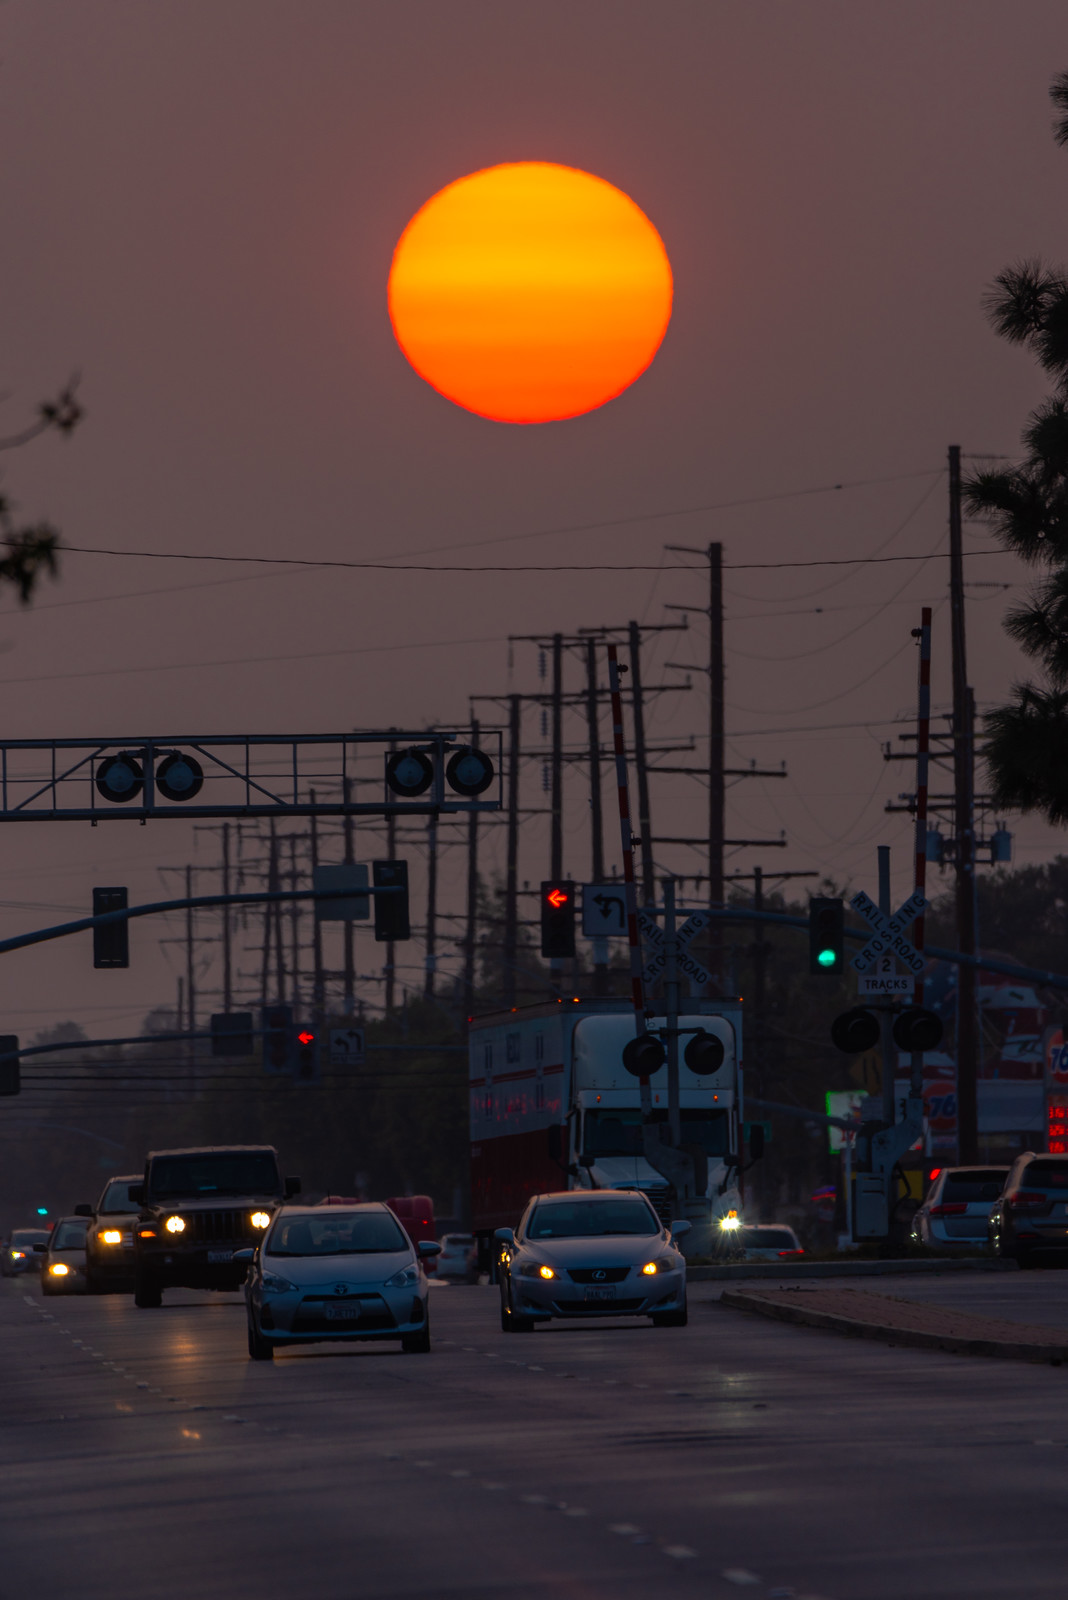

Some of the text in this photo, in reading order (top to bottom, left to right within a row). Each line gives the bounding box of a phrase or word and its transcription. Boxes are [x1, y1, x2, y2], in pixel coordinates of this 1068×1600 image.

[853, 895, 923, 970] RAIL ROAD
[854, 895, 925, 970] CROSSING
[641, 916, 702, 984] CROING
[676, 953, 707, 984] ROAD
[882, 958, 891, 972] 2
[865, 980, 908, 990] TRACKS
[1051, 1043, 1068, 1070] 76
[930, 1094, 956, 1117] 76
